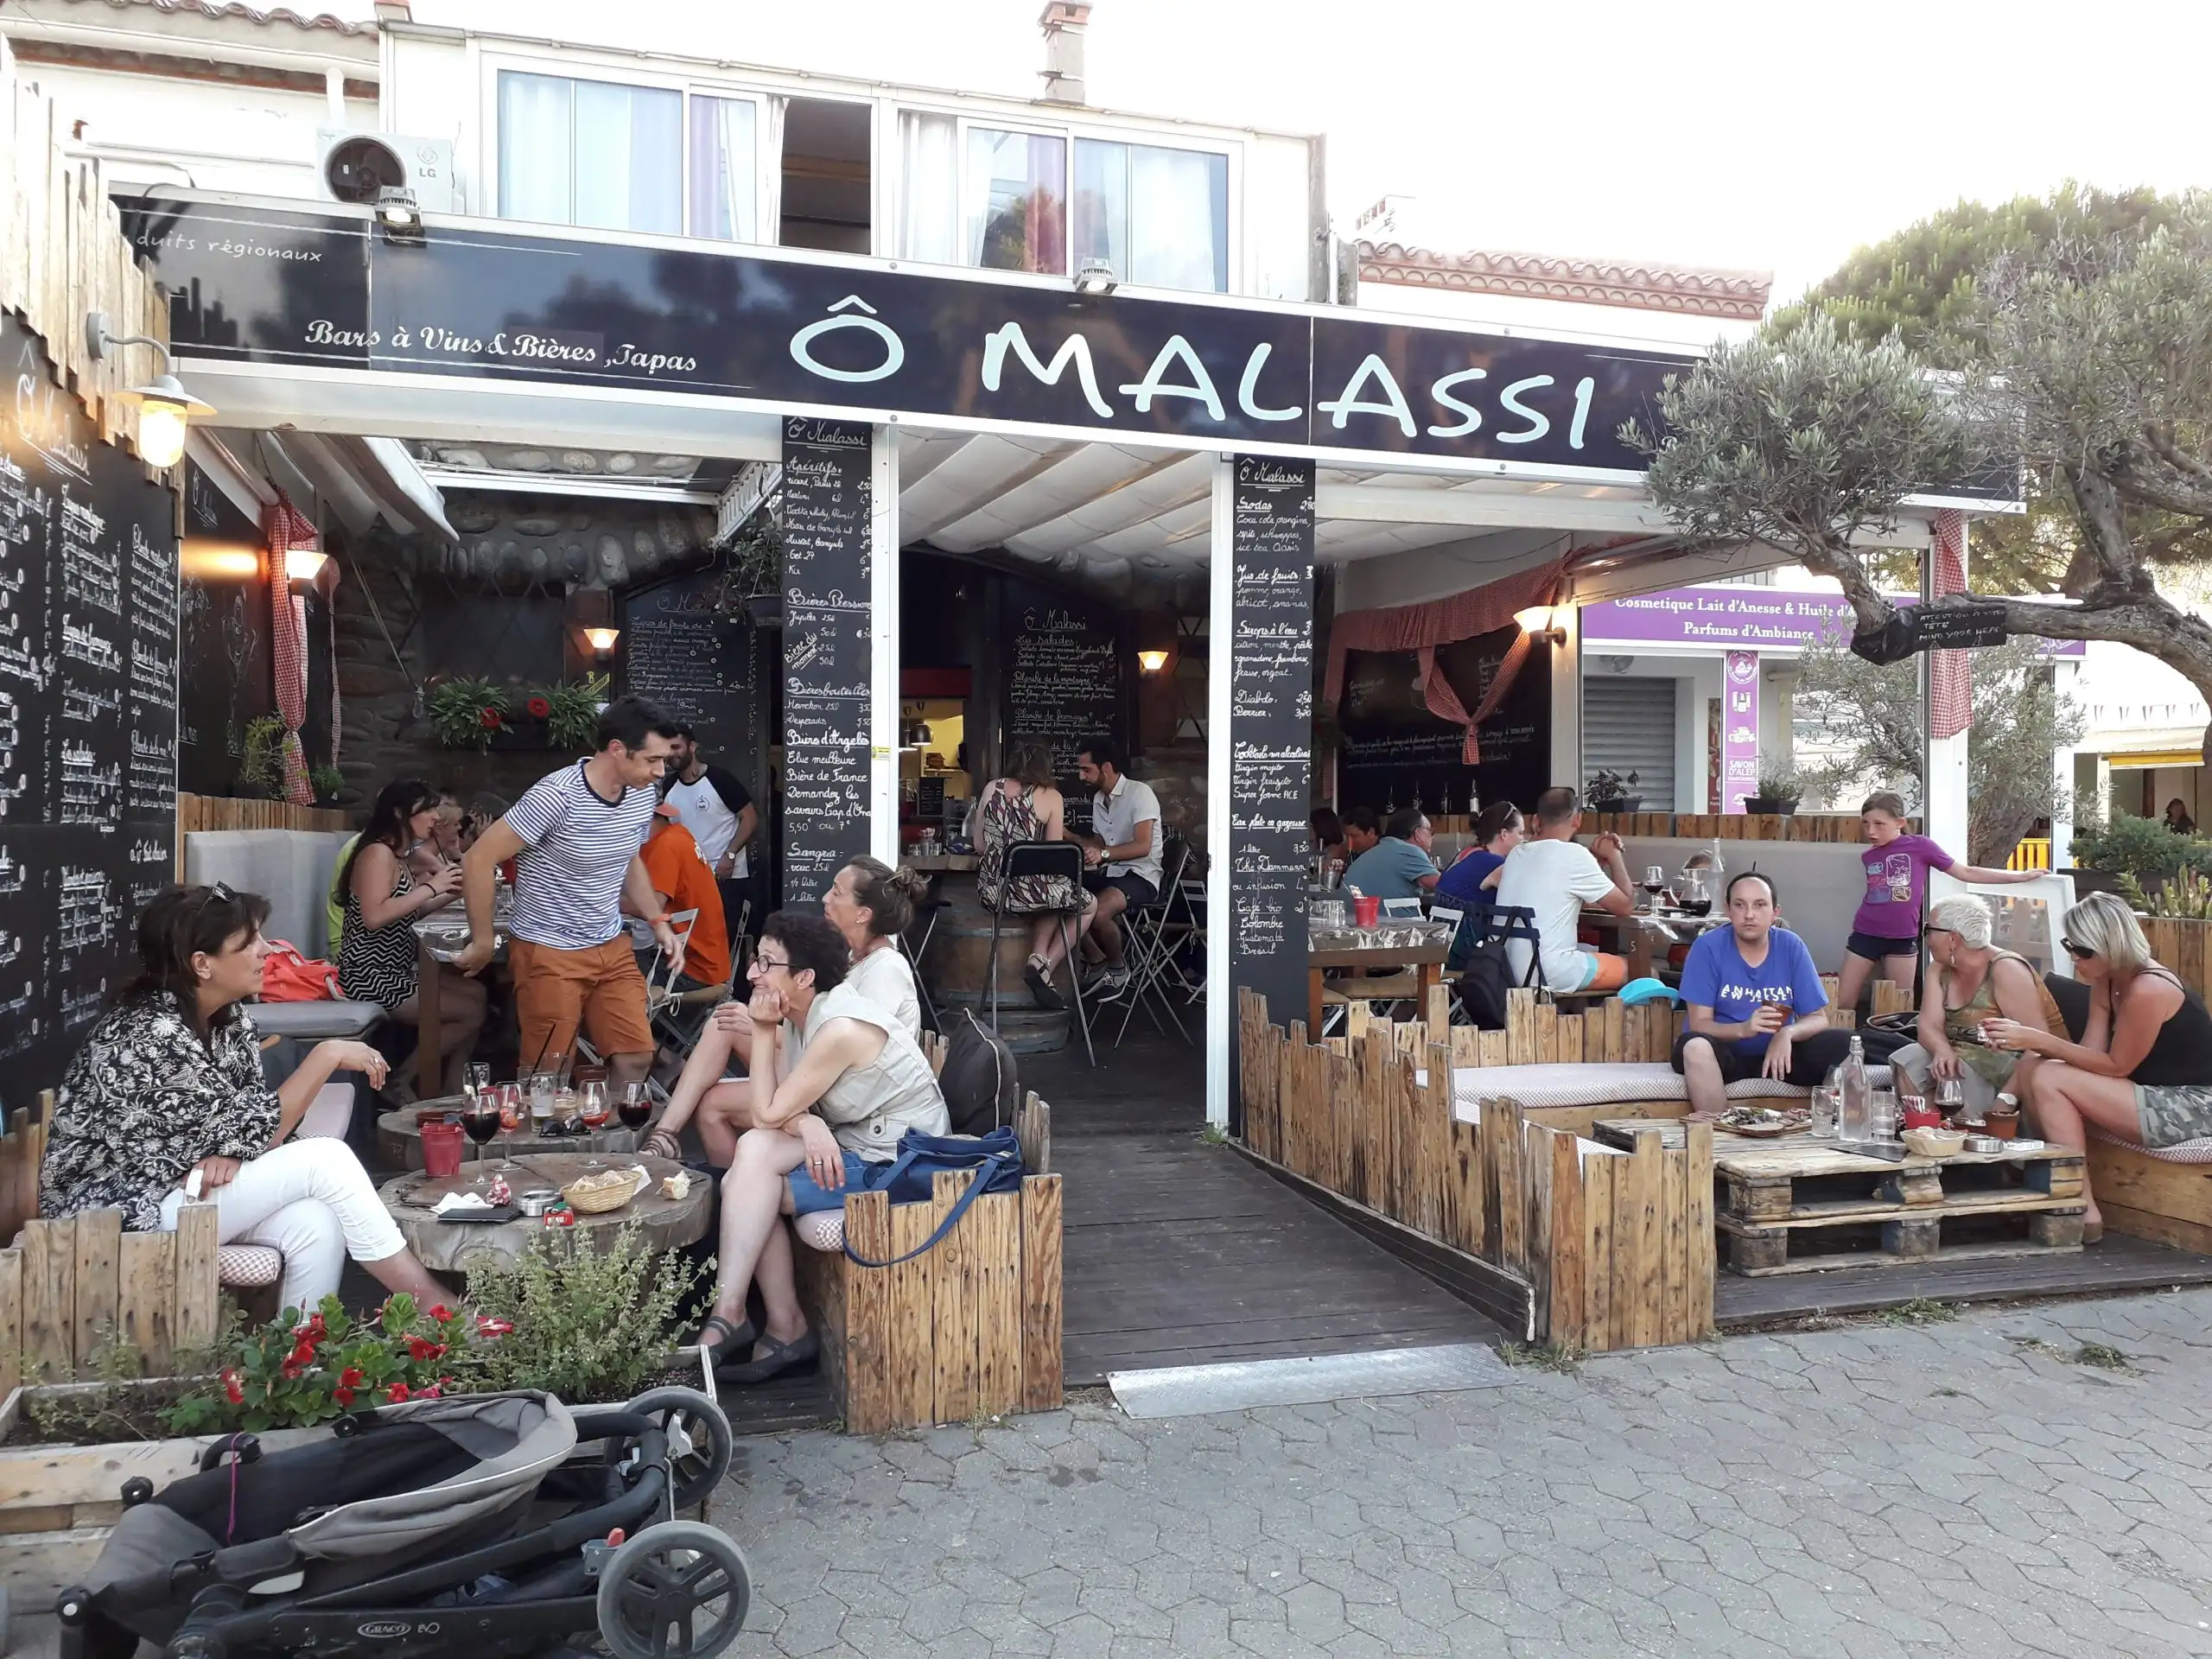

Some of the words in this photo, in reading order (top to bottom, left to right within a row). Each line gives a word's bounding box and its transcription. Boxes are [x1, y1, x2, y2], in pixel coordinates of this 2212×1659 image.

[419, 167, 436, 178] LG
[136, 228, 196, 251] duits
[207, 238, 322, 263] régionaux
[304, 320, 381, 347] Bars
[391, 326, 412, 348] à
[420, 326, 483, 354] Vins
[512, 334, 596, 363] Bières
[982, 321, 1596, 449] MALASSI
[807, 419, 868, 446] Malassi
[1254, 461, 1306, 484] Malassi
[1236, 495, 1273, 510] Sodas
[806, 523, 816, 531] de
[1236, 513, 1257, 524] Coca
[1272, 541, 1300, 552] Oasis
[1236, 563, 1255, 588] Jus
[1255, 569, 1269, 581] de
[1697, 597, 1725, 613] Lait
[1727, 598, 1782, 614] d'Anesse
[1784, 601, 1795, 615] &
[1837, 604, 1857, 618] d'A
[1682, 621, 1738, 637] Parfums
[1741, 623, 1815, 639] d'Ambiance
[1918, 632, 1943, 641] MIND
[787, 750, 809, 764] Elue
[812, 750, 857, 766] meilleure
[785, 767, 814, 781] Bière
[817, 769, 830, 781] de
[831, 766, 868, 782] France
[1259, 763, 1286, 776] mojito
[787, 785, 841, 804] Demandez
[845, 784, 860, 799] les
[1233, 786, 1257, 804] Super
[1283, 790, 1299, 799] ACE
[1274, 819, 1306, 834] gazeuse
[1256, 855, 1307, 871] Dammann
[1246, 877, 1287, 899] infusion
[1236, 896, 1262, 919] Café
[1266, 895, 1282, 912] bio
[1239, 929, 1285, 948] Guatemala
[1241, 942, 1276, 955] Brésil
